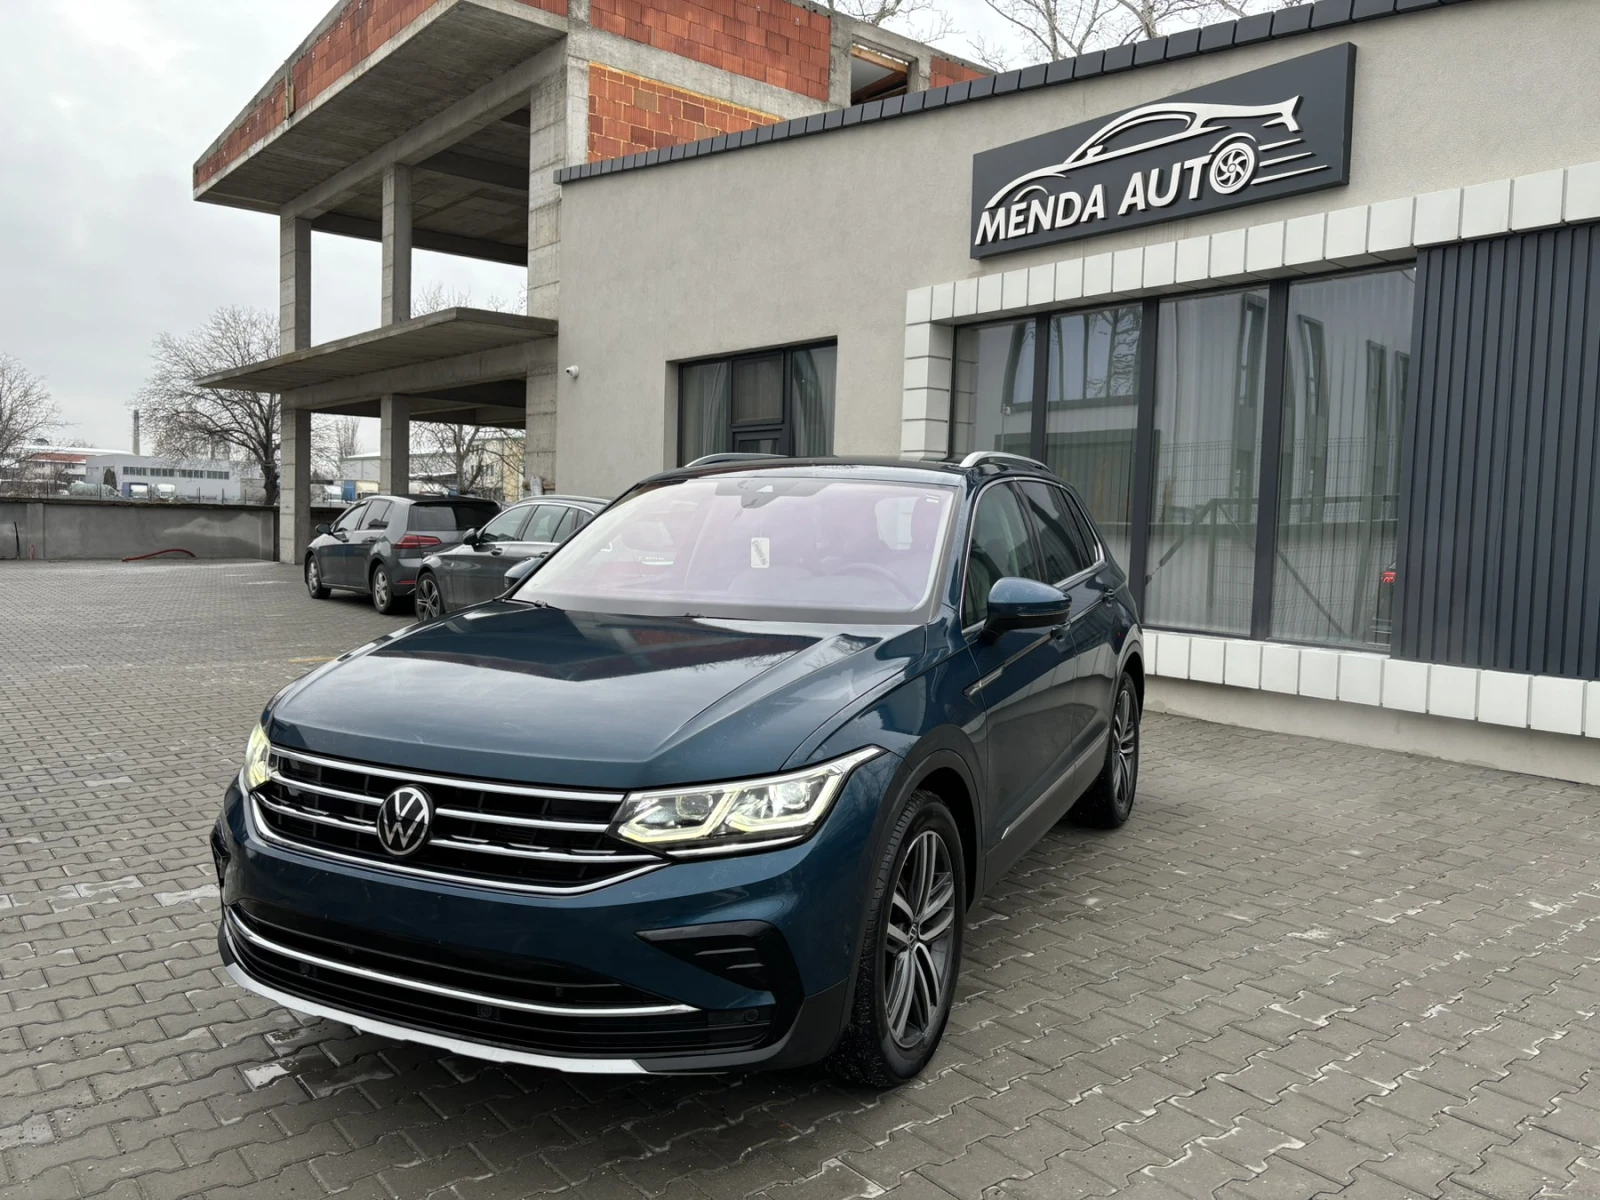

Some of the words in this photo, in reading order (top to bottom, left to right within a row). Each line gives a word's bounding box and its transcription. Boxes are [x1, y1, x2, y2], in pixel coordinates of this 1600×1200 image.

[974, 184, 1105, 246] MENDA
[1118, 142, 1255, 216] AUTO
[380, 789, 428, 852] VW
